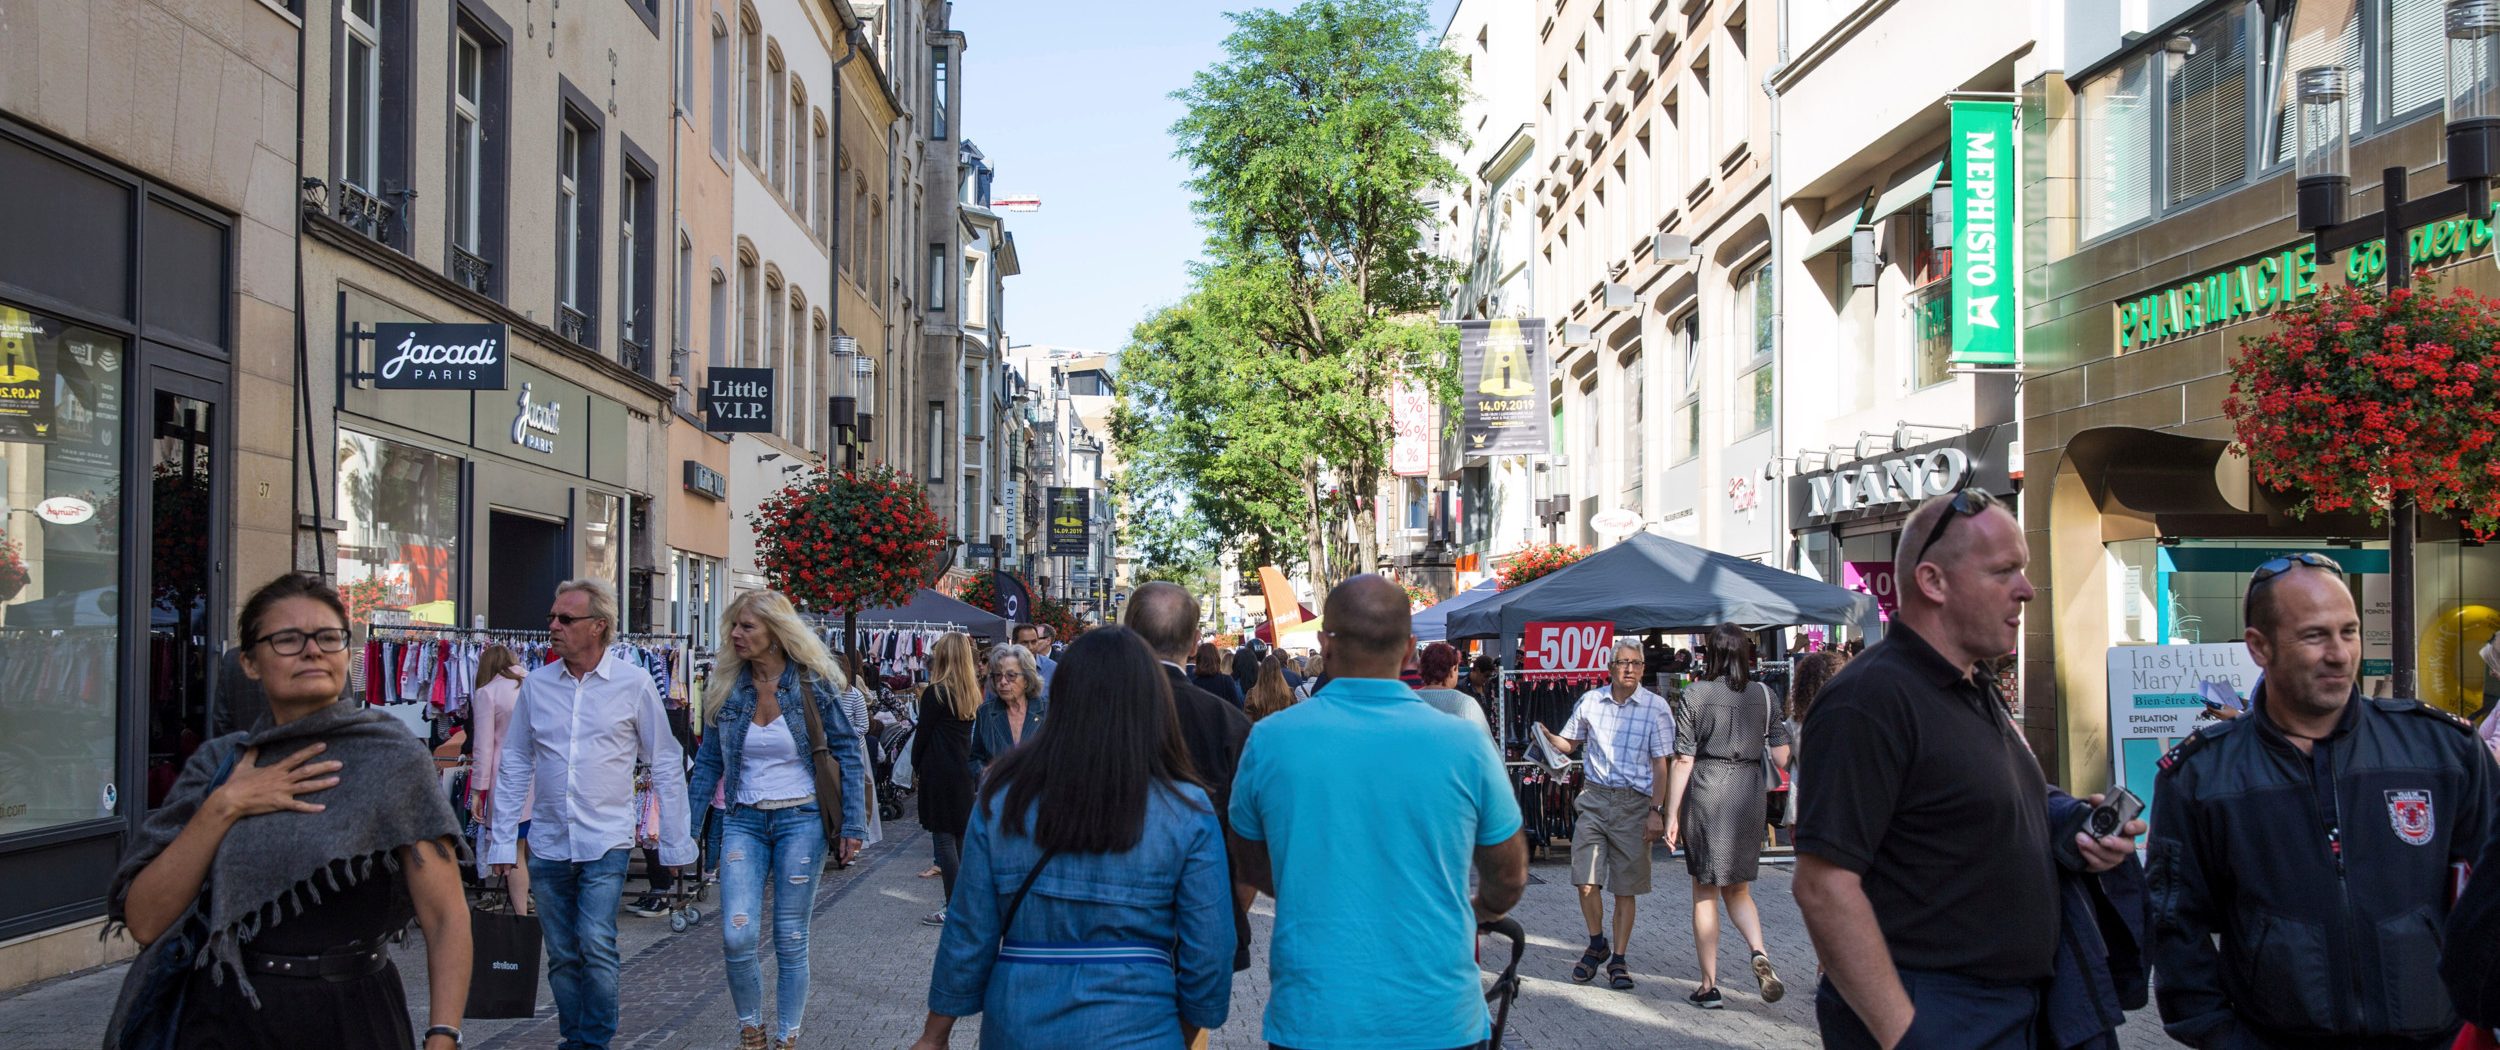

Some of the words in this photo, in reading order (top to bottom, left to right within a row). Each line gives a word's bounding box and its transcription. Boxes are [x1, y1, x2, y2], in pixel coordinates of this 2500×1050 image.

[1966, 131, 1996, 287] MEPHISTO
[2121, 243, 2317, 348] PHARMACIE
[382, 331, 497, 379] jacadi
[415, 369, 477, 380] PARIS
[712, 380, 768, 398] Little
[512, 382, 560, 445] jacadi
[712, 402, 767, 419] V.I.P.
[1478, 399, 1535, 412] 14.09.2019
[526, 434, 554, 454] PARIS
[259, 482, 270, 497] 37
[1808, 448, 1971, 517] MANO
[1006, 488, 1014, 540] RITUALS
[1526, 626, 1611, 670] -50%
[2130, 647, 2240, 669] Institut
[2132, 667, 2242, 694] Mary'Anna
[2135, 696, 2186, 706] Bien-être
[2129, 714, 2178, 723] EPILATION
[2133, 726, 2176, 734] DEFINITIVE
